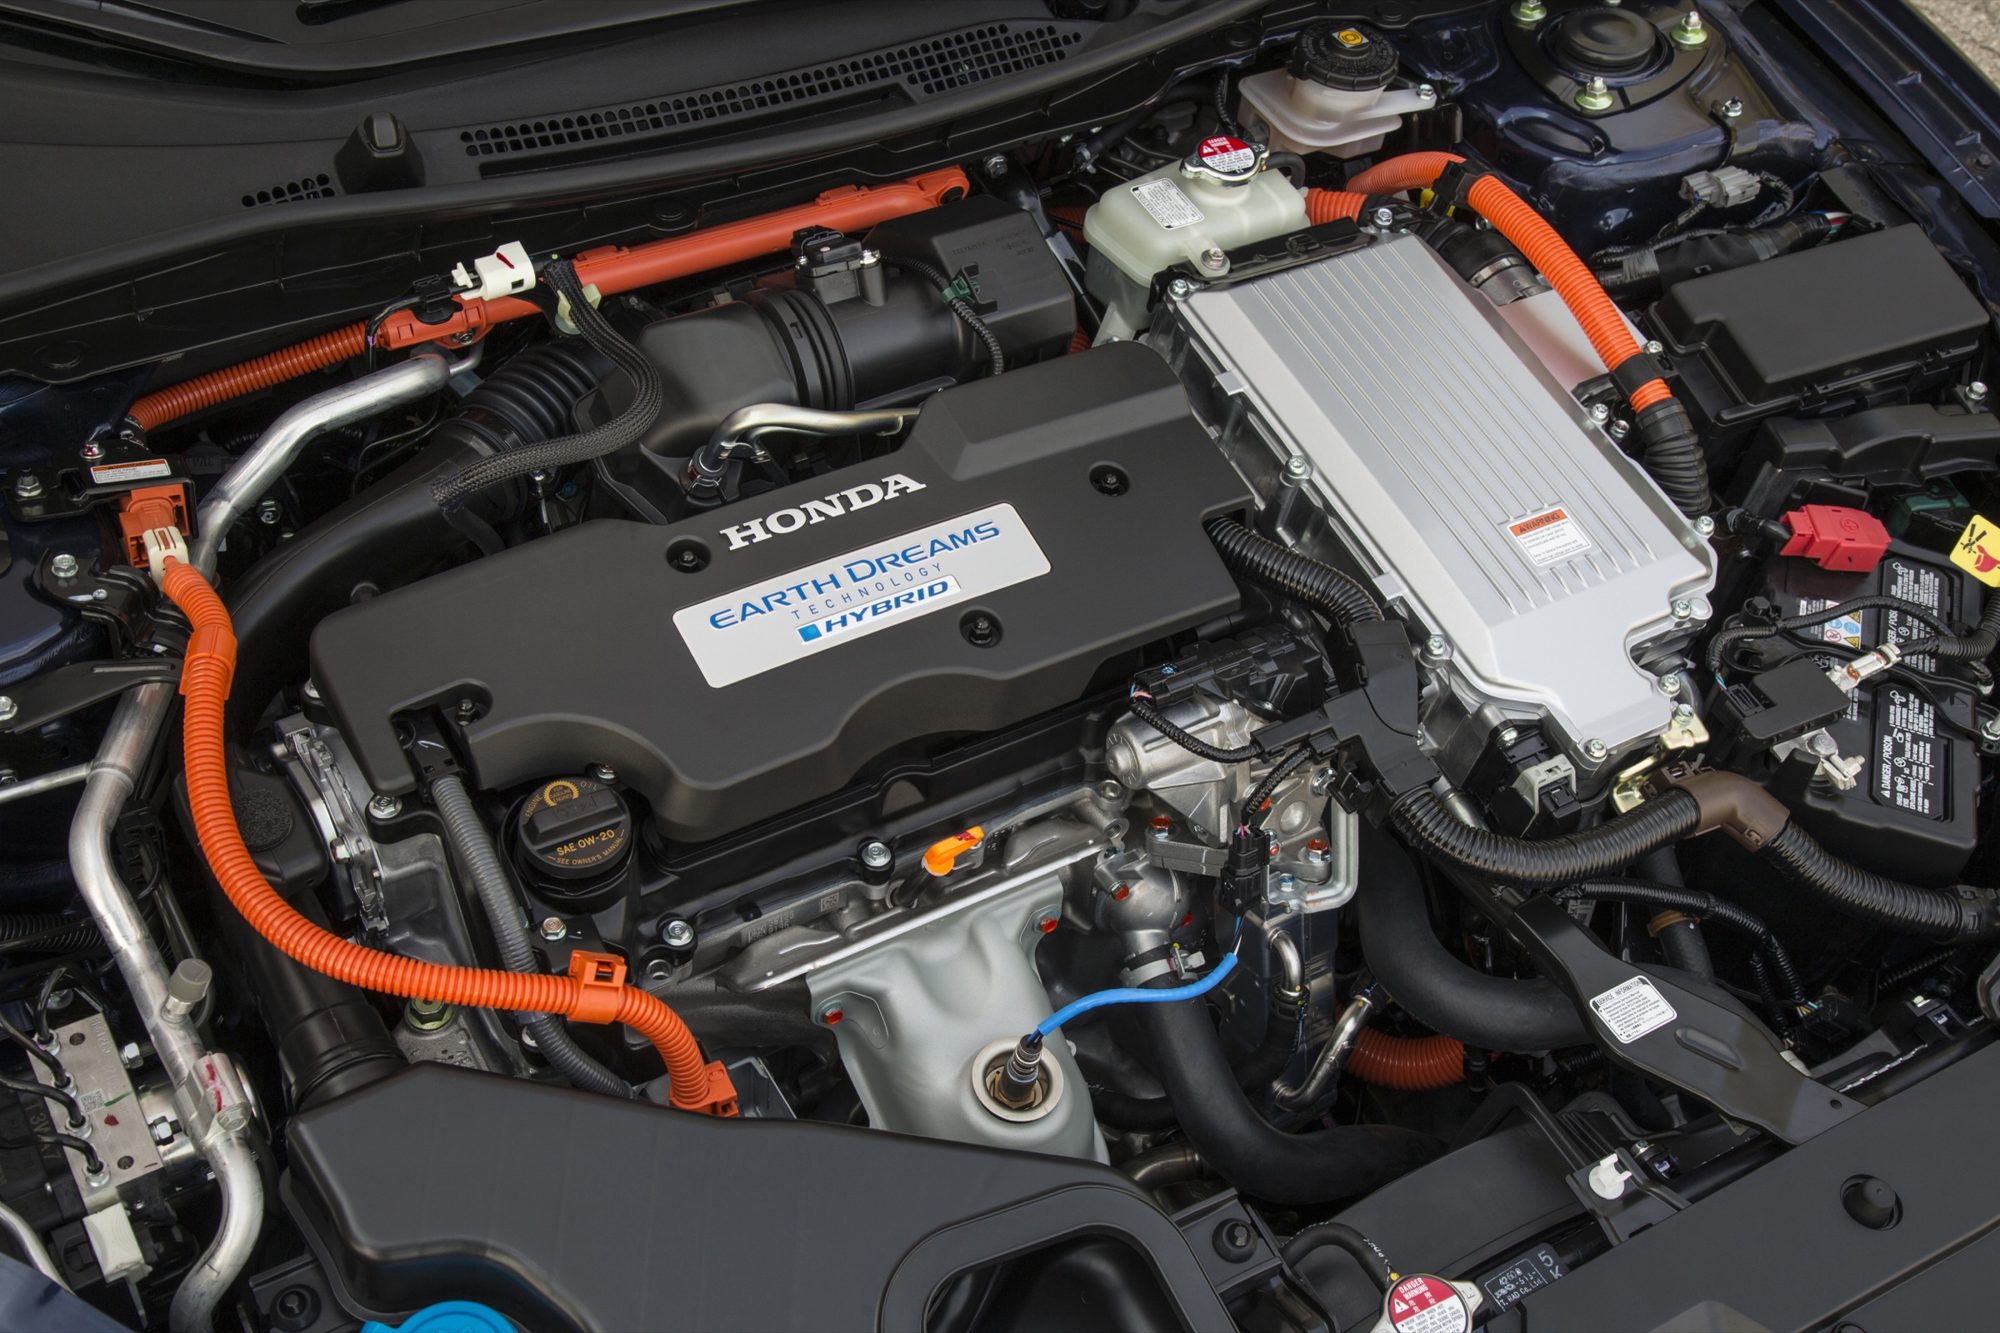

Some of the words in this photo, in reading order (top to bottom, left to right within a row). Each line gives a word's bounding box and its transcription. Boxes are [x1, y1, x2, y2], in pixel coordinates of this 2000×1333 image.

[719, 473, 927, 551] HONDA
[709, 573, 842, 630] EARTH
[843, 521, 1000, 580] DREAMS
[791, 562, 943, 620] TECHNOLOGY
[825, 580, 949, 633] HYBRID
[525, 793, 544, 817] ENGINE
[580, 780, 599, 790] OIL
[556, 842, 576, 856] SAE
[578, 829, 615, 849] 0W-20
[556, 857, 569, 865] SEE
[572, 855, 602, 865] OWNER'S
[603, 838, 623, 856] MANUAL
[1537, 1249, 1554, 1268] 5
[1549, 1265, 1563, 1279] K
[1398, 1277, 1425, 1294] DANGER
[1506, 1291, 1520, 1303] RAD
